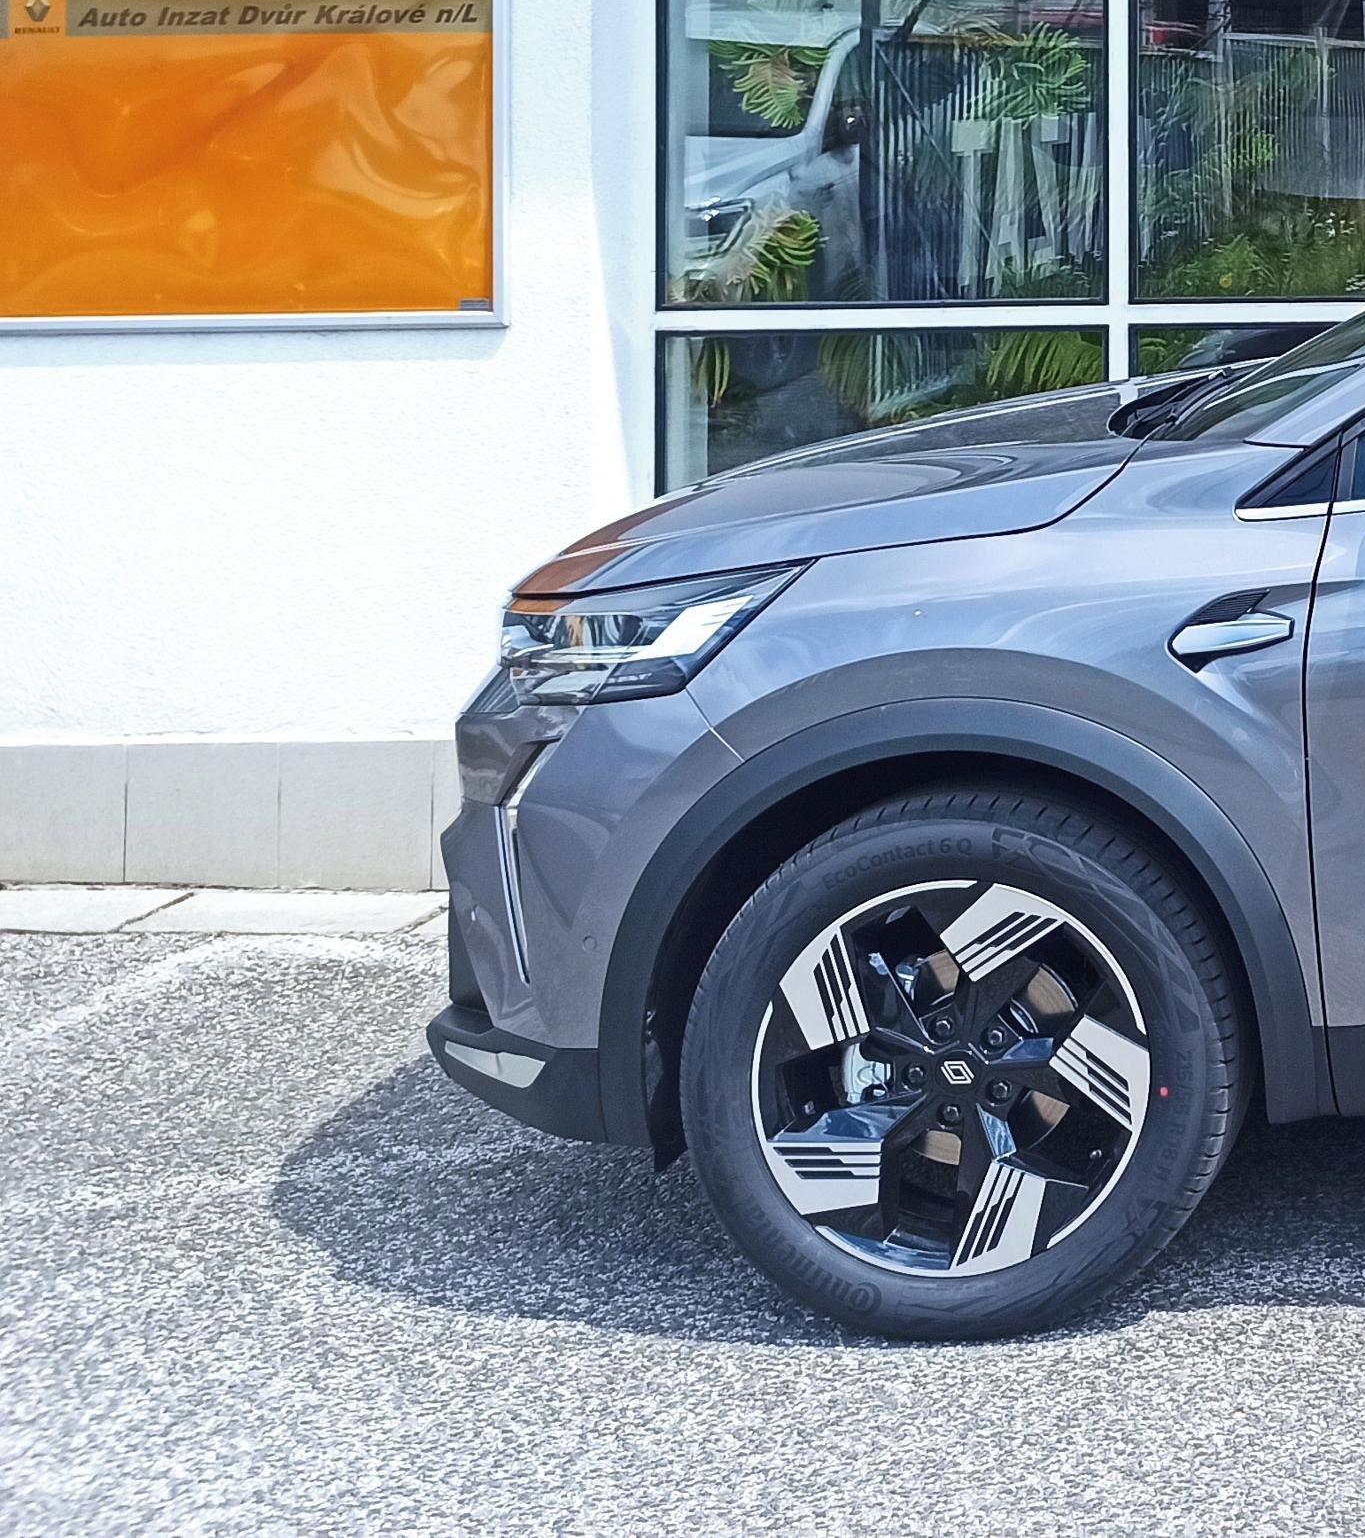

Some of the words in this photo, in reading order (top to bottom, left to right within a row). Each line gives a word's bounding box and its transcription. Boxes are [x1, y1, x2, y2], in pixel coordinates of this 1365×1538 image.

[78, 6, 147, 29] Auto
[157, 3, 231, 27] Inzat
[237, 2, 305, 26] Dvůr
[313, 3, 425, 26] Králové
[822, 840, 935, 890] EcoContact
[939, 837, 952, 854] 6
[957, 837, 973, 856] Q
